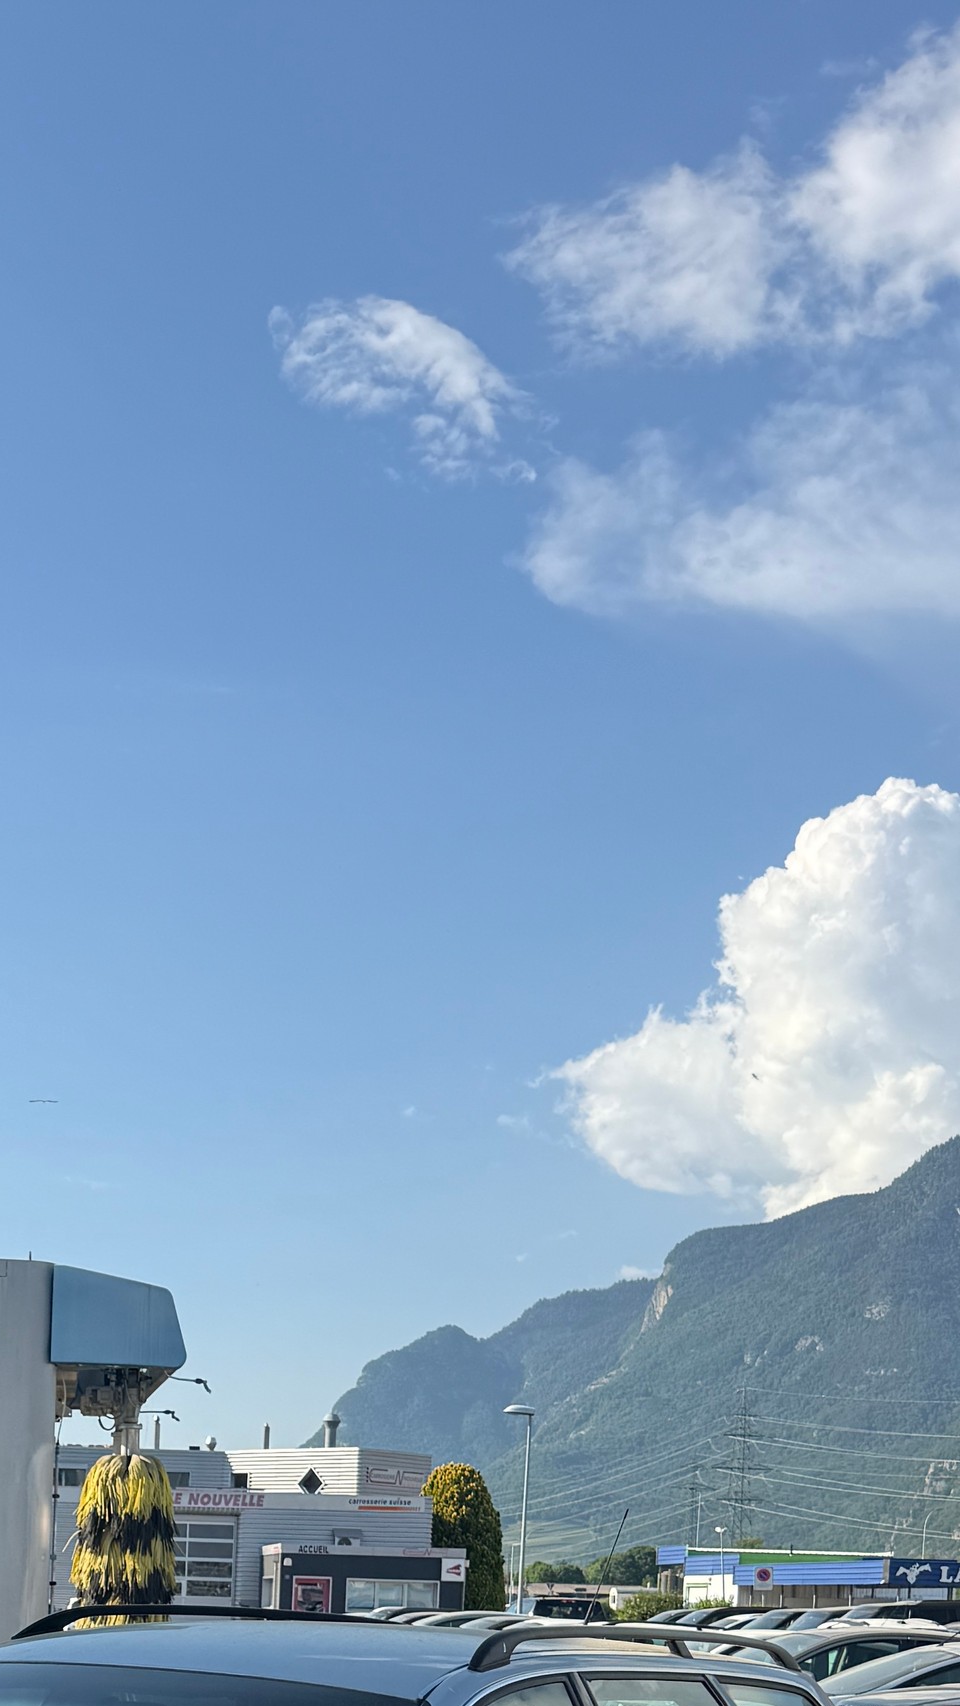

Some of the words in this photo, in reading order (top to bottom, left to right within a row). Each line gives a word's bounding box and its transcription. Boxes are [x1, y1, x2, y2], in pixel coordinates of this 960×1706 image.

[188, 1493, 265, 1507] NOUVELLE
[389, 1497, 411, 1506] suisse
[298, 1545, 329, 1554] ACCUEIL
